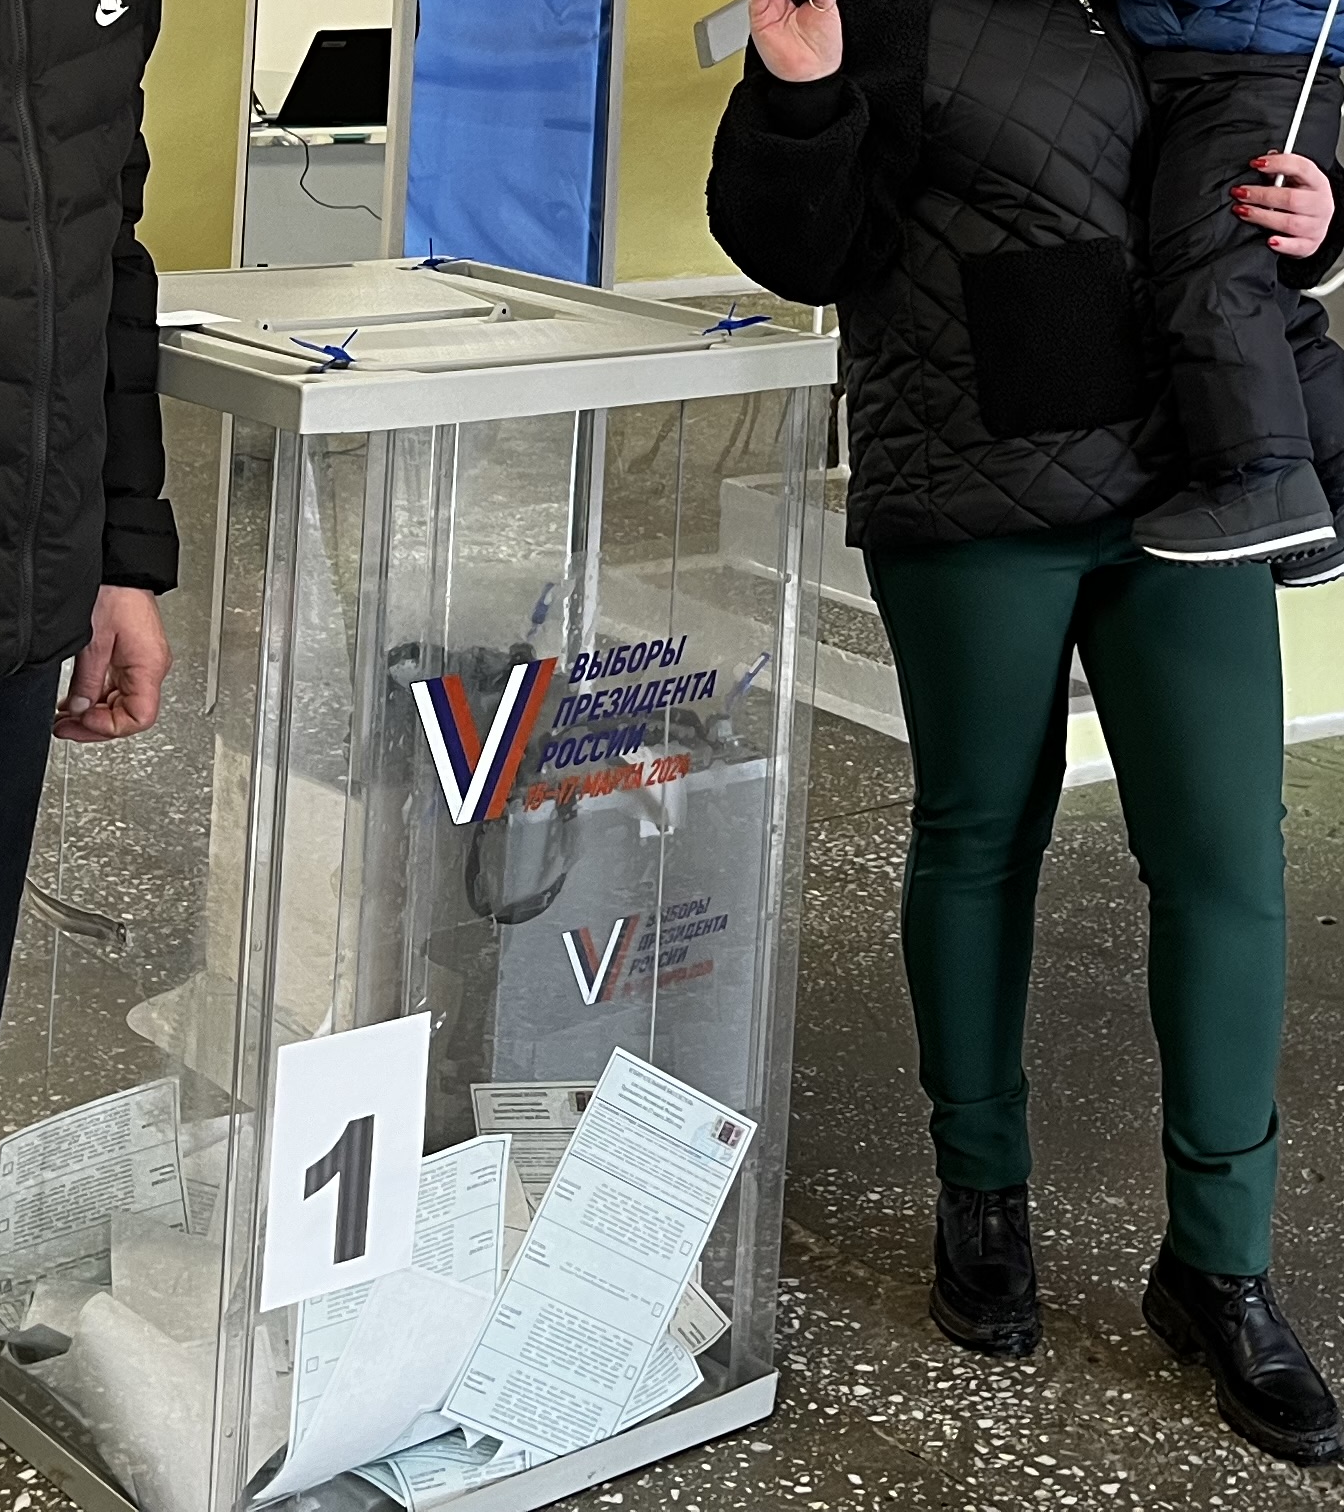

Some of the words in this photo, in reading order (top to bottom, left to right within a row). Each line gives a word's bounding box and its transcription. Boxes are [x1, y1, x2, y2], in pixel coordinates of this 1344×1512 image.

[568, 635, 688, 684] ВЫБОРЫ
[552, 669, 718, 729] ПРЕЗИДЕНТА
[536, 723, 647, 773] РОССИИ
[302, 1114, 376, 1265] 1
